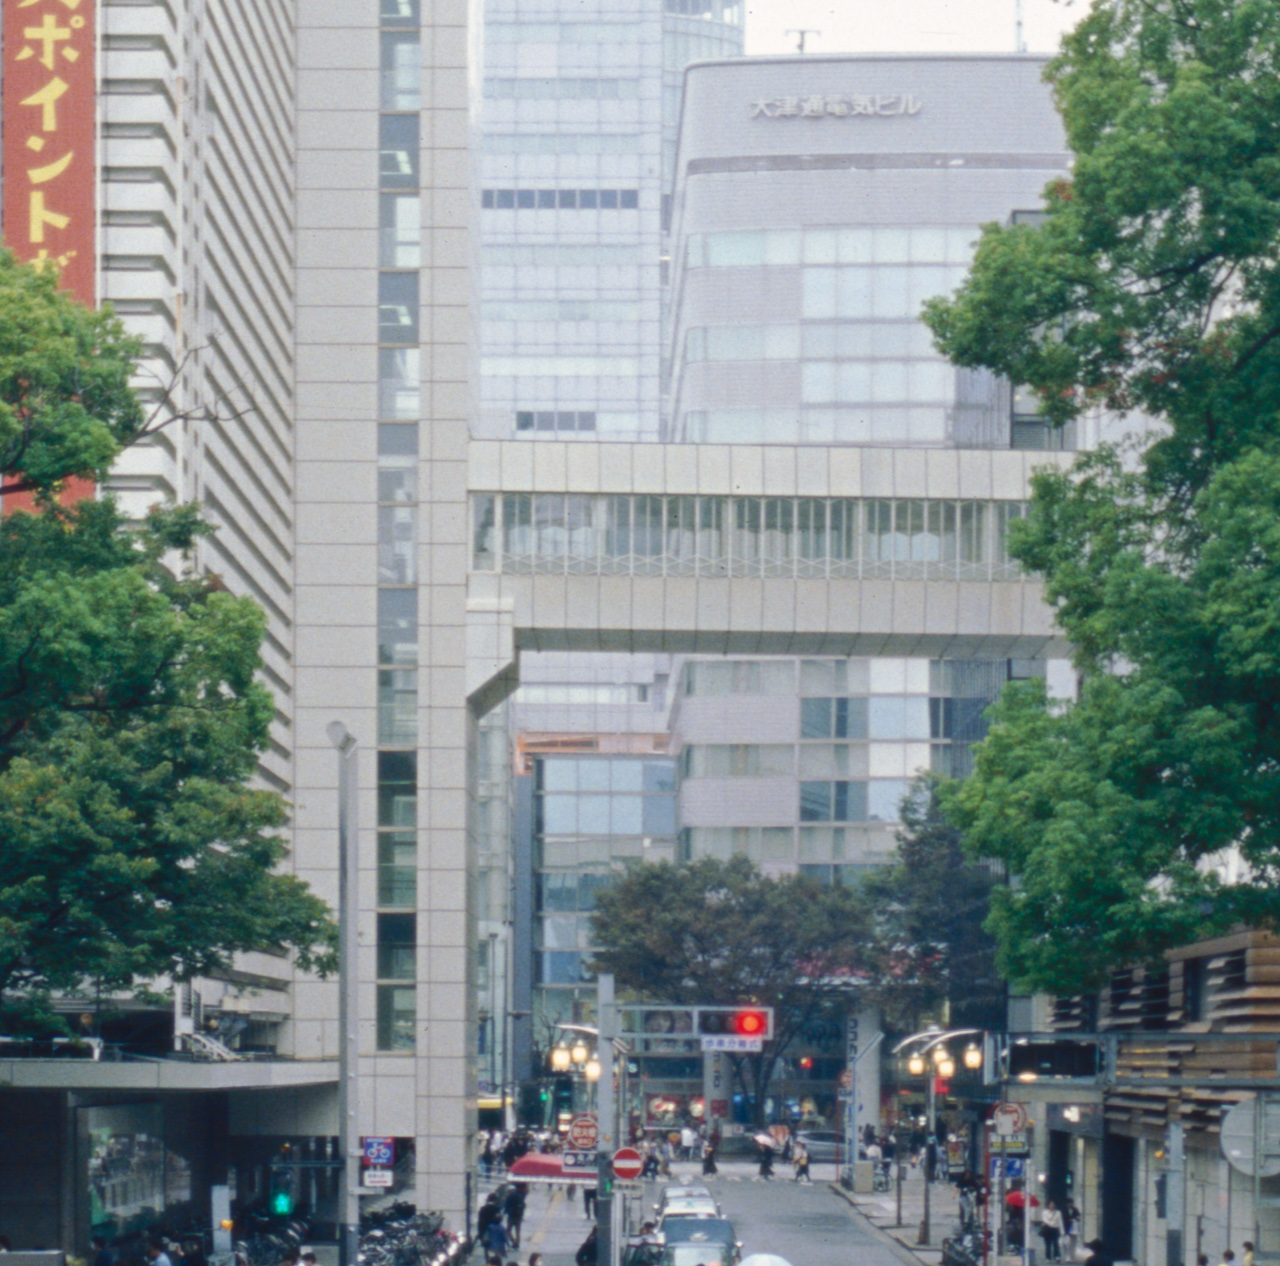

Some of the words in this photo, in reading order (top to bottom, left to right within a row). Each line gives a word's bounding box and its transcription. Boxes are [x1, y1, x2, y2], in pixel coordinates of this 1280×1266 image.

[750, 94, 923, 118] 大津通電気ビル
